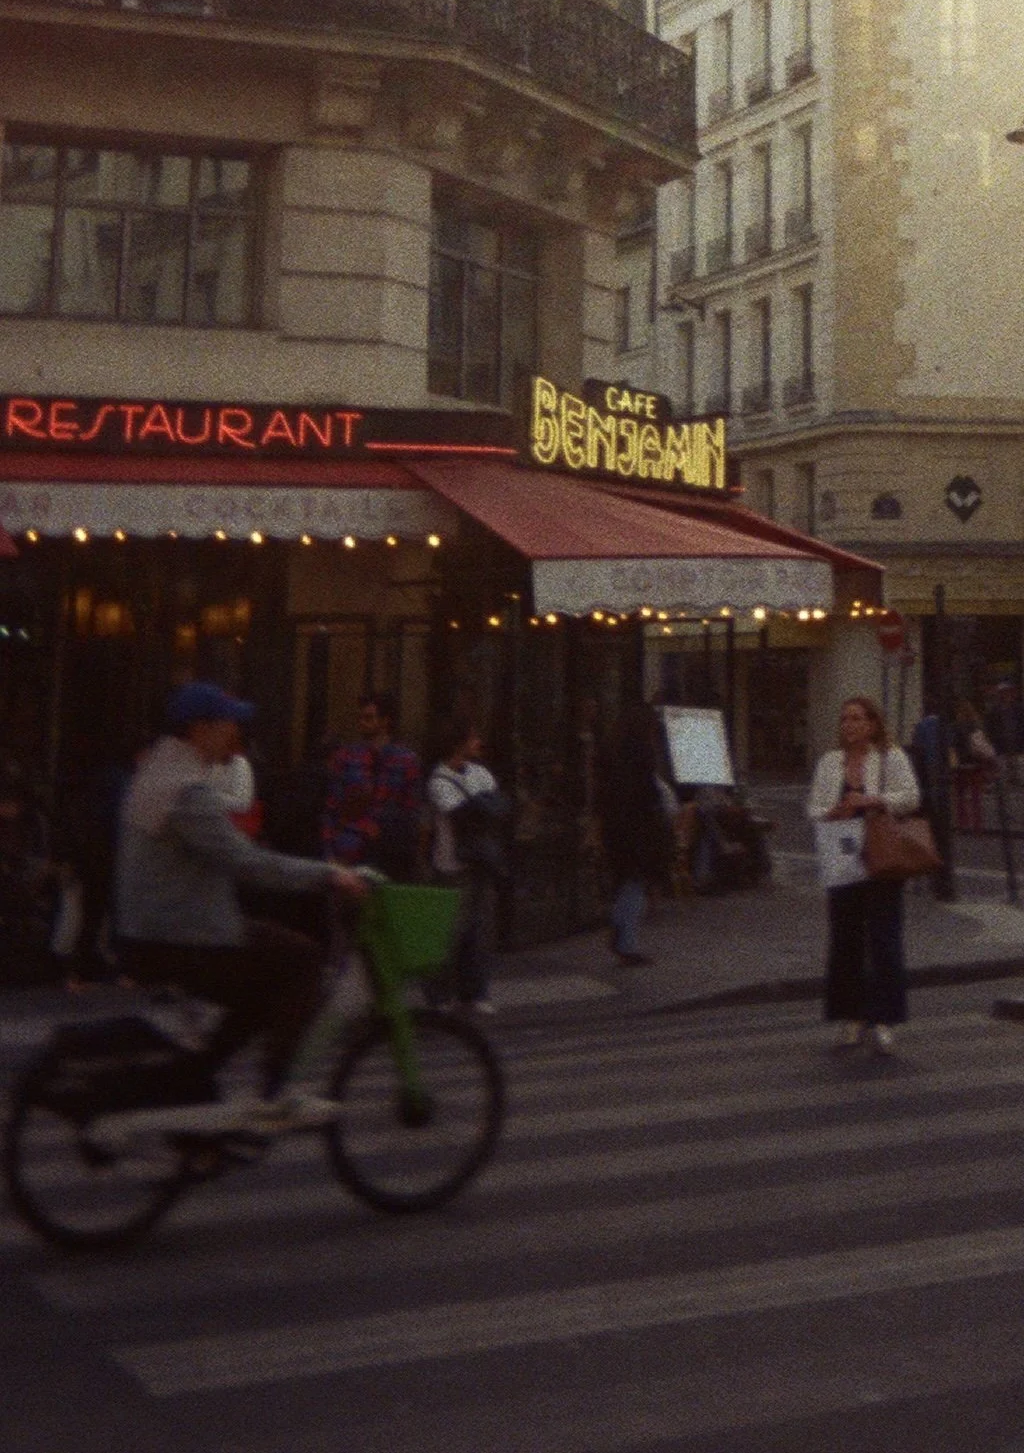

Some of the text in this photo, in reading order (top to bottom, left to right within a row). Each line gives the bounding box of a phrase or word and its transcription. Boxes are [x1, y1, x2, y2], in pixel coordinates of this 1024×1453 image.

[5, 398, 363, 450] RESTAURANT
[604, 385, 658, 420] CAFE
[533, 375, 726, 490] BENJAMIN
